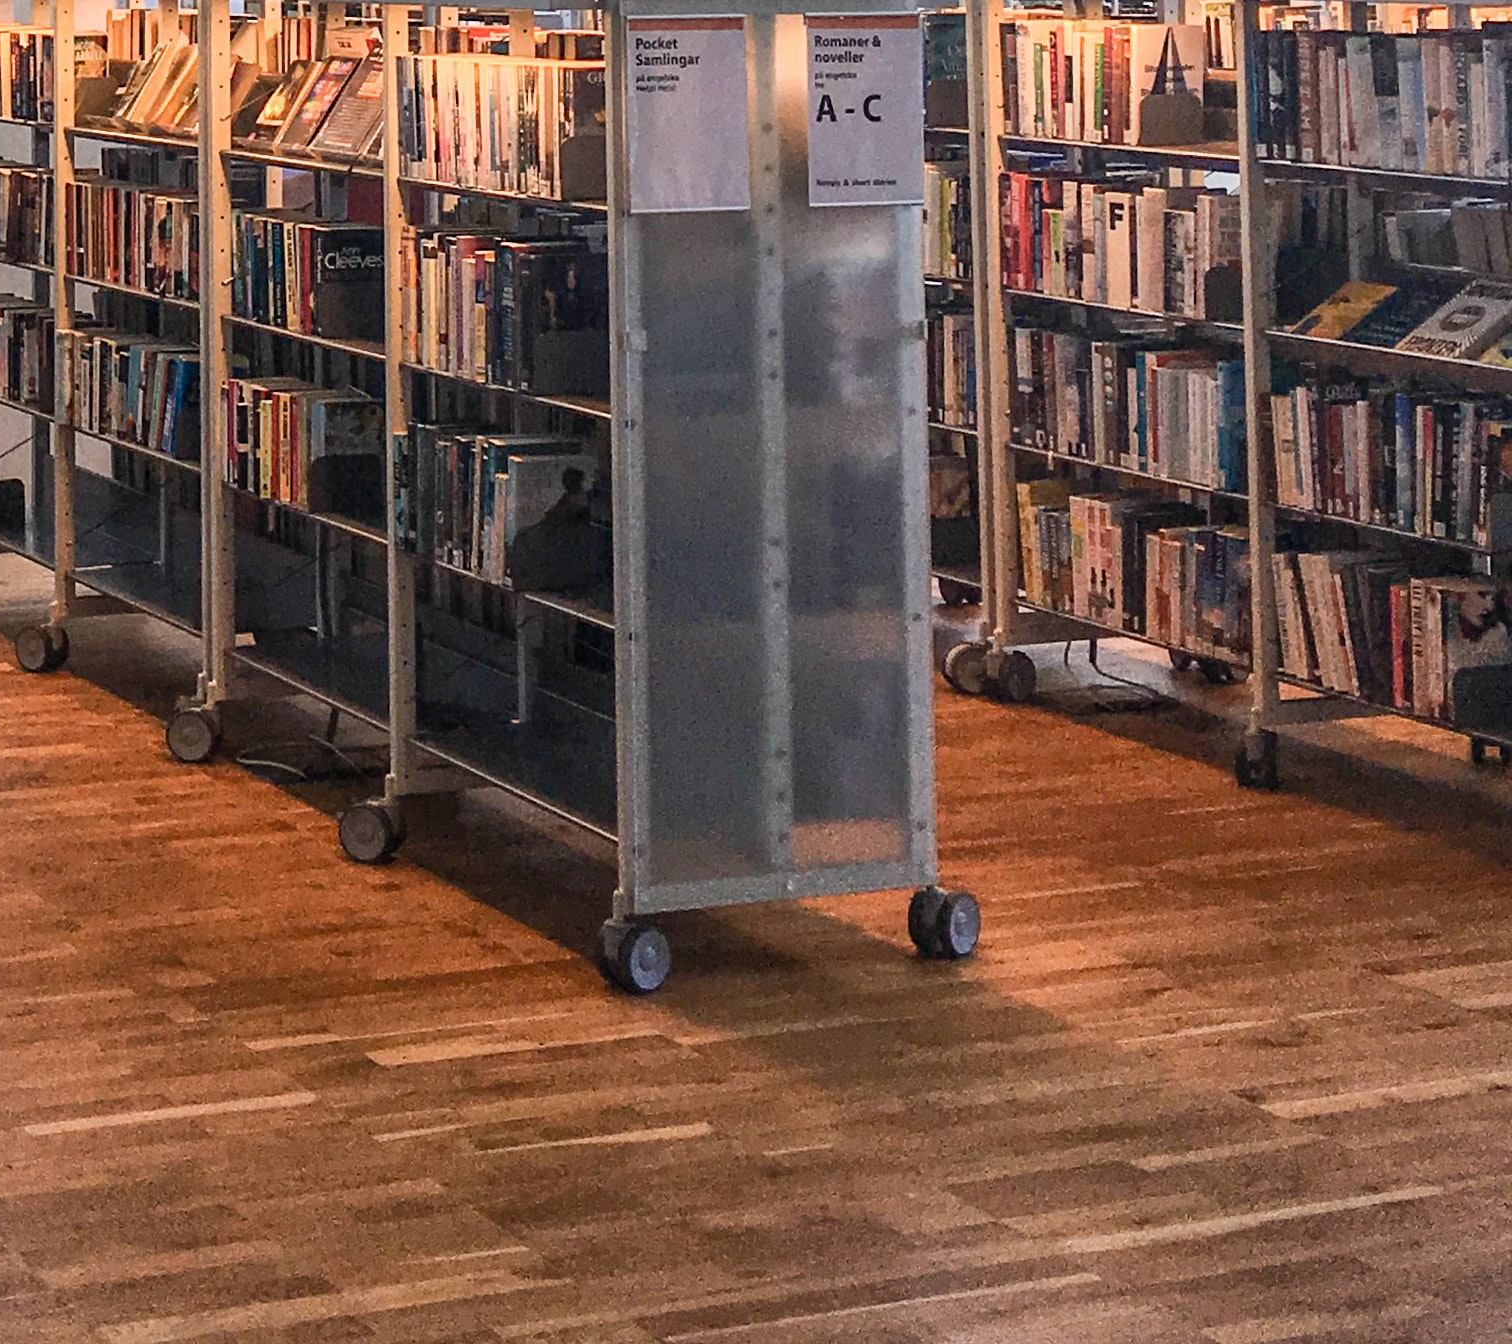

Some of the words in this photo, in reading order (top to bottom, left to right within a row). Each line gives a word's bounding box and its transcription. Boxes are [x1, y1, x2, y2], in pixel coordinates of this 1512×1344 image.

[635, 36, 678, 50] Pocket
[814, 35, 870, 48] Romaner
[872, 35, 881, 48] &
[635, 53, 701, 69] Samlingar
[814, 51, 865, 63] noveller
[815, 93, 838, 123] A
[862, 93, 882, 123] C
[324, 251, 385, 270] Cleeves
